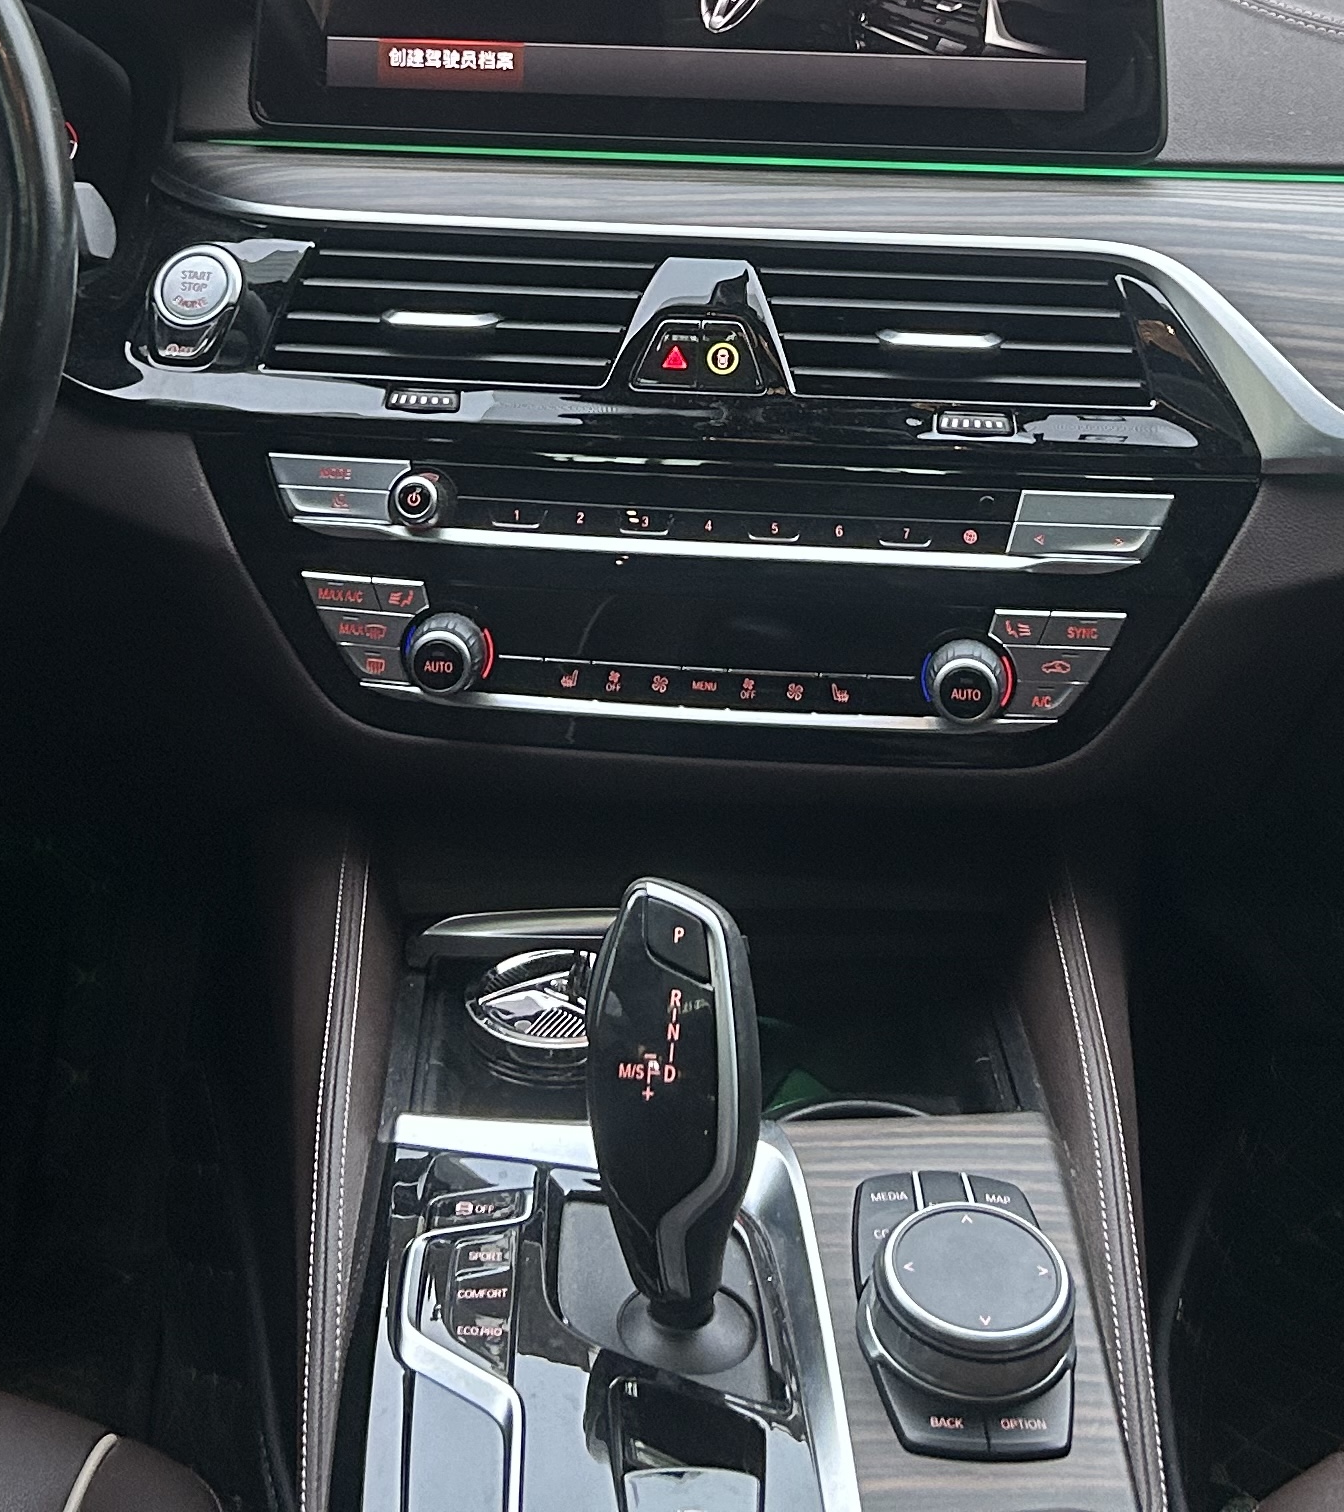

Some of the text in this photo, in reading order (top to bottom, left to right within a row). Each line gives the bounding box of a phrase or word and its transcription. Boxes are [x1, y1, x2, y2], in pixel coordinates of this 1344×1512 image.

[388, 48, 514, 71] 创建驾驶员档案
[181, 270, 213, 281] START
[181, 281, 208, 292] STOP
[513, 509, 520, 522] 1
[576, 511, 585, 524] 2
[641, 515, 649, 527] 3
[704, 519, 712, 532] 4
[770, 522, 779, 534] 5
[834, 525, 843, 537] 6
[902, 528, 911, 540] 7
[1066, 626, 1098, 639] SYNC
[424, 660, 454, 674] AUTO
[605, 683, 621, 693] OFF
[692, 681, 718, 692] MENU
[740, 689, 757, 700] OFF
[950, 688, 982, 702] AUTO
[1031, 695, 1053, 708] A/C
[673, 926, 685, 944] P
[670, 988, 682, 1007] R
[667, 1023, 681, 1041] N
[618, 1062, 645, 1080] M/S
[663, 1064, 676, 1083] D
[870, 1191, 909, 1202] MEDIA
[985, 1193, 1011, 1205] MAP
[474, 1204, 495, 1215] OFF
[468, 1251, 503, 1262] SPORT
[457, 1287, 508, 1299] COMFORT
[456, 1325, 503, 1337] ECO PRO
[930, 1415, 965, 1430] BACK
[1000, 1417, 1048, 1431] OPTION
